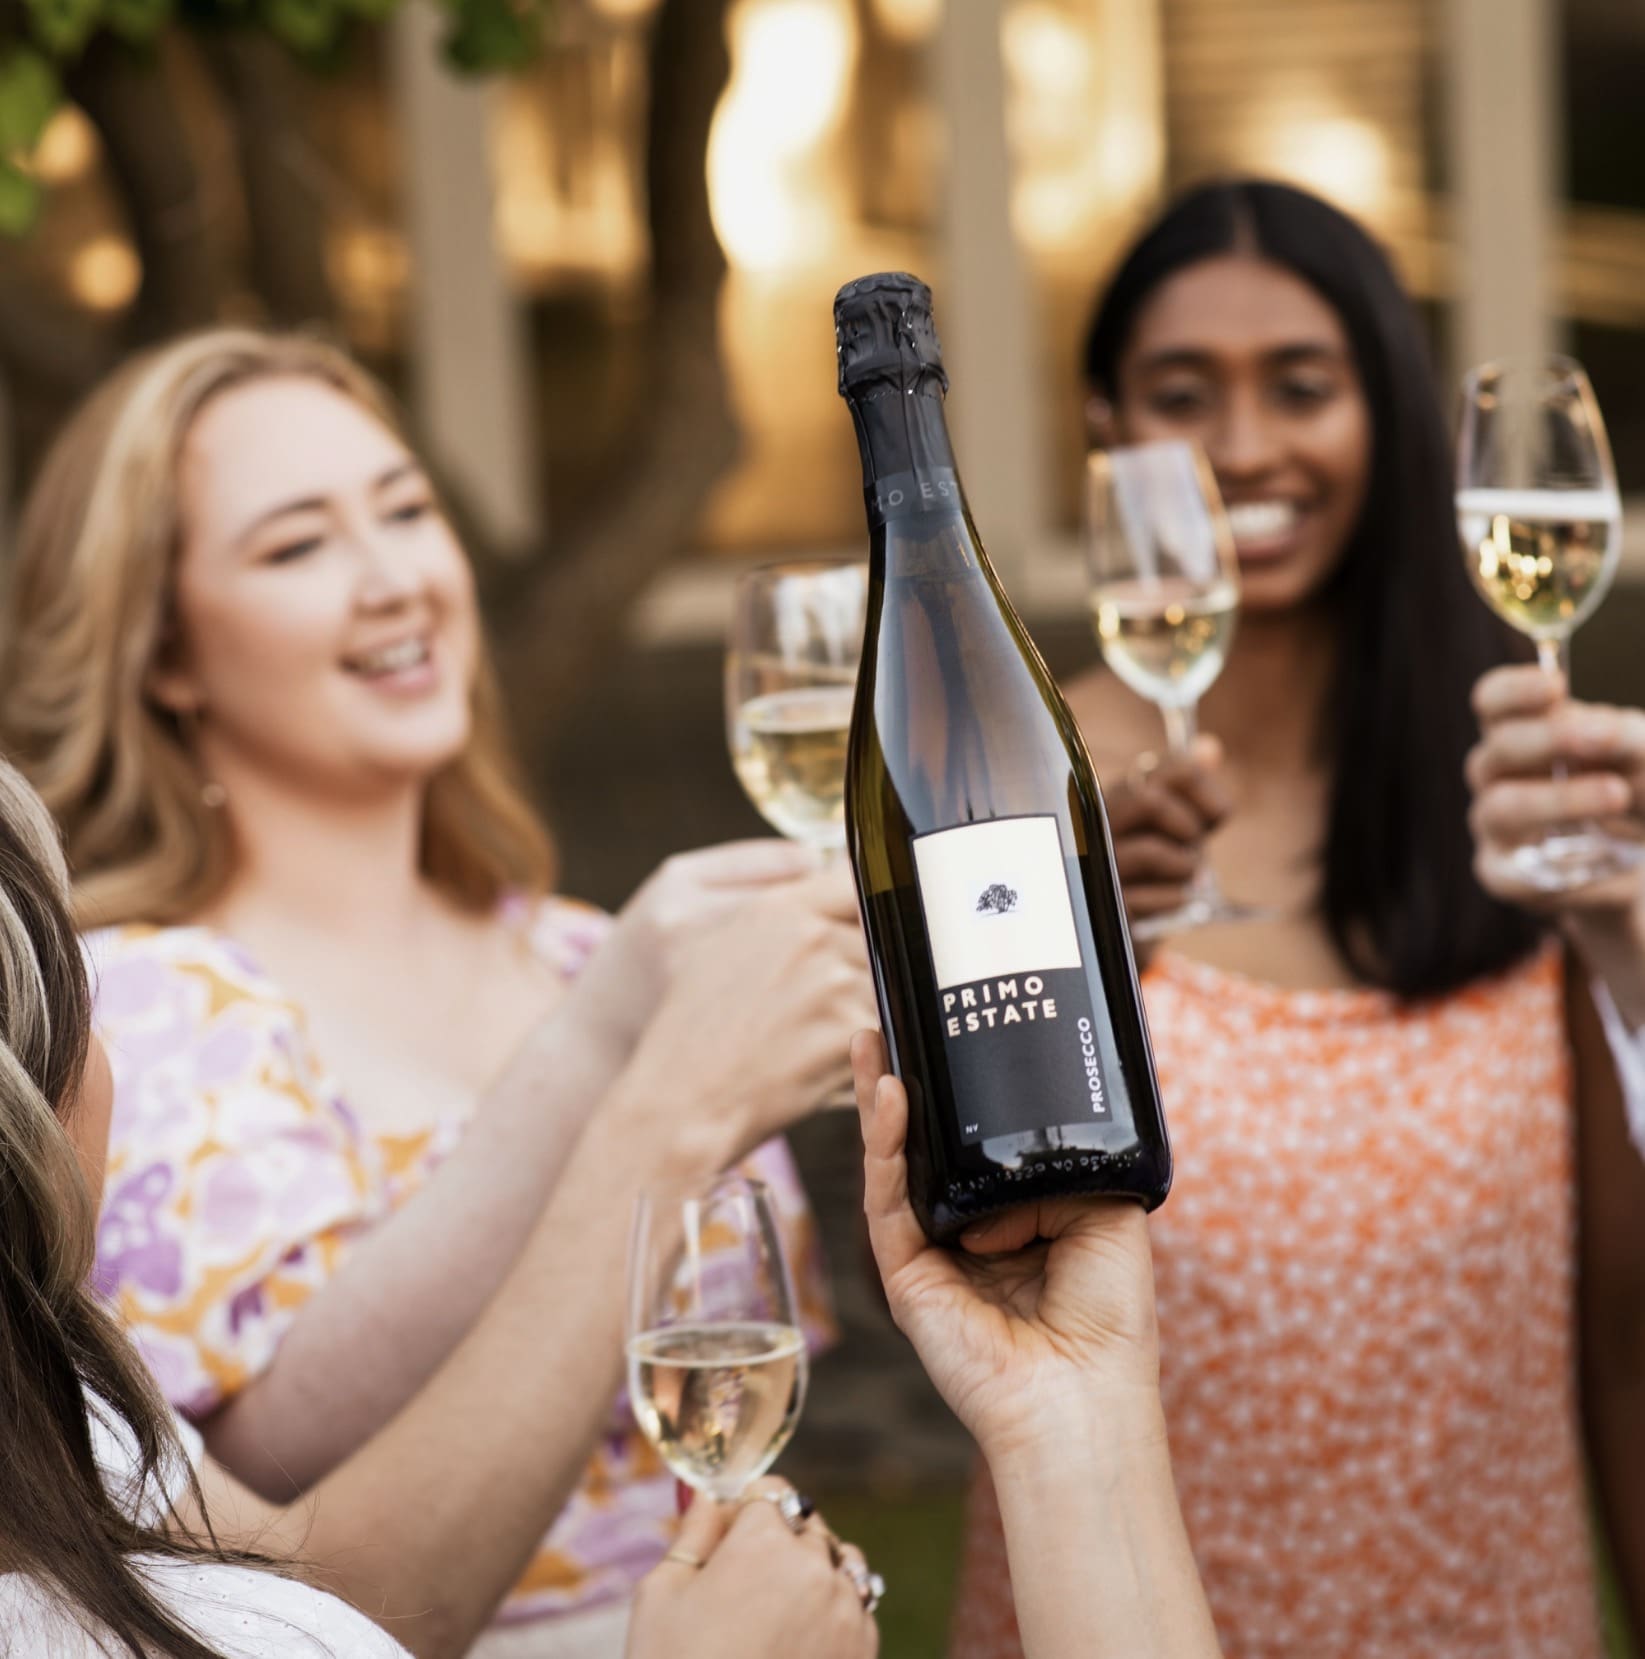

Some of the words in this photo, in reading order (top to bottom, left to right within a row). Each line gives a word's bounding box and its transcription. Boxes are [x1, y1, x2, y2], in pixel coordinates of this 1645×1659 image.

[943, 976, 1044, 1013] PRIMO
[946, 998, 1057, 1037] ESTATE
[1077, 1016, 1105, 1113] PROSECCO
